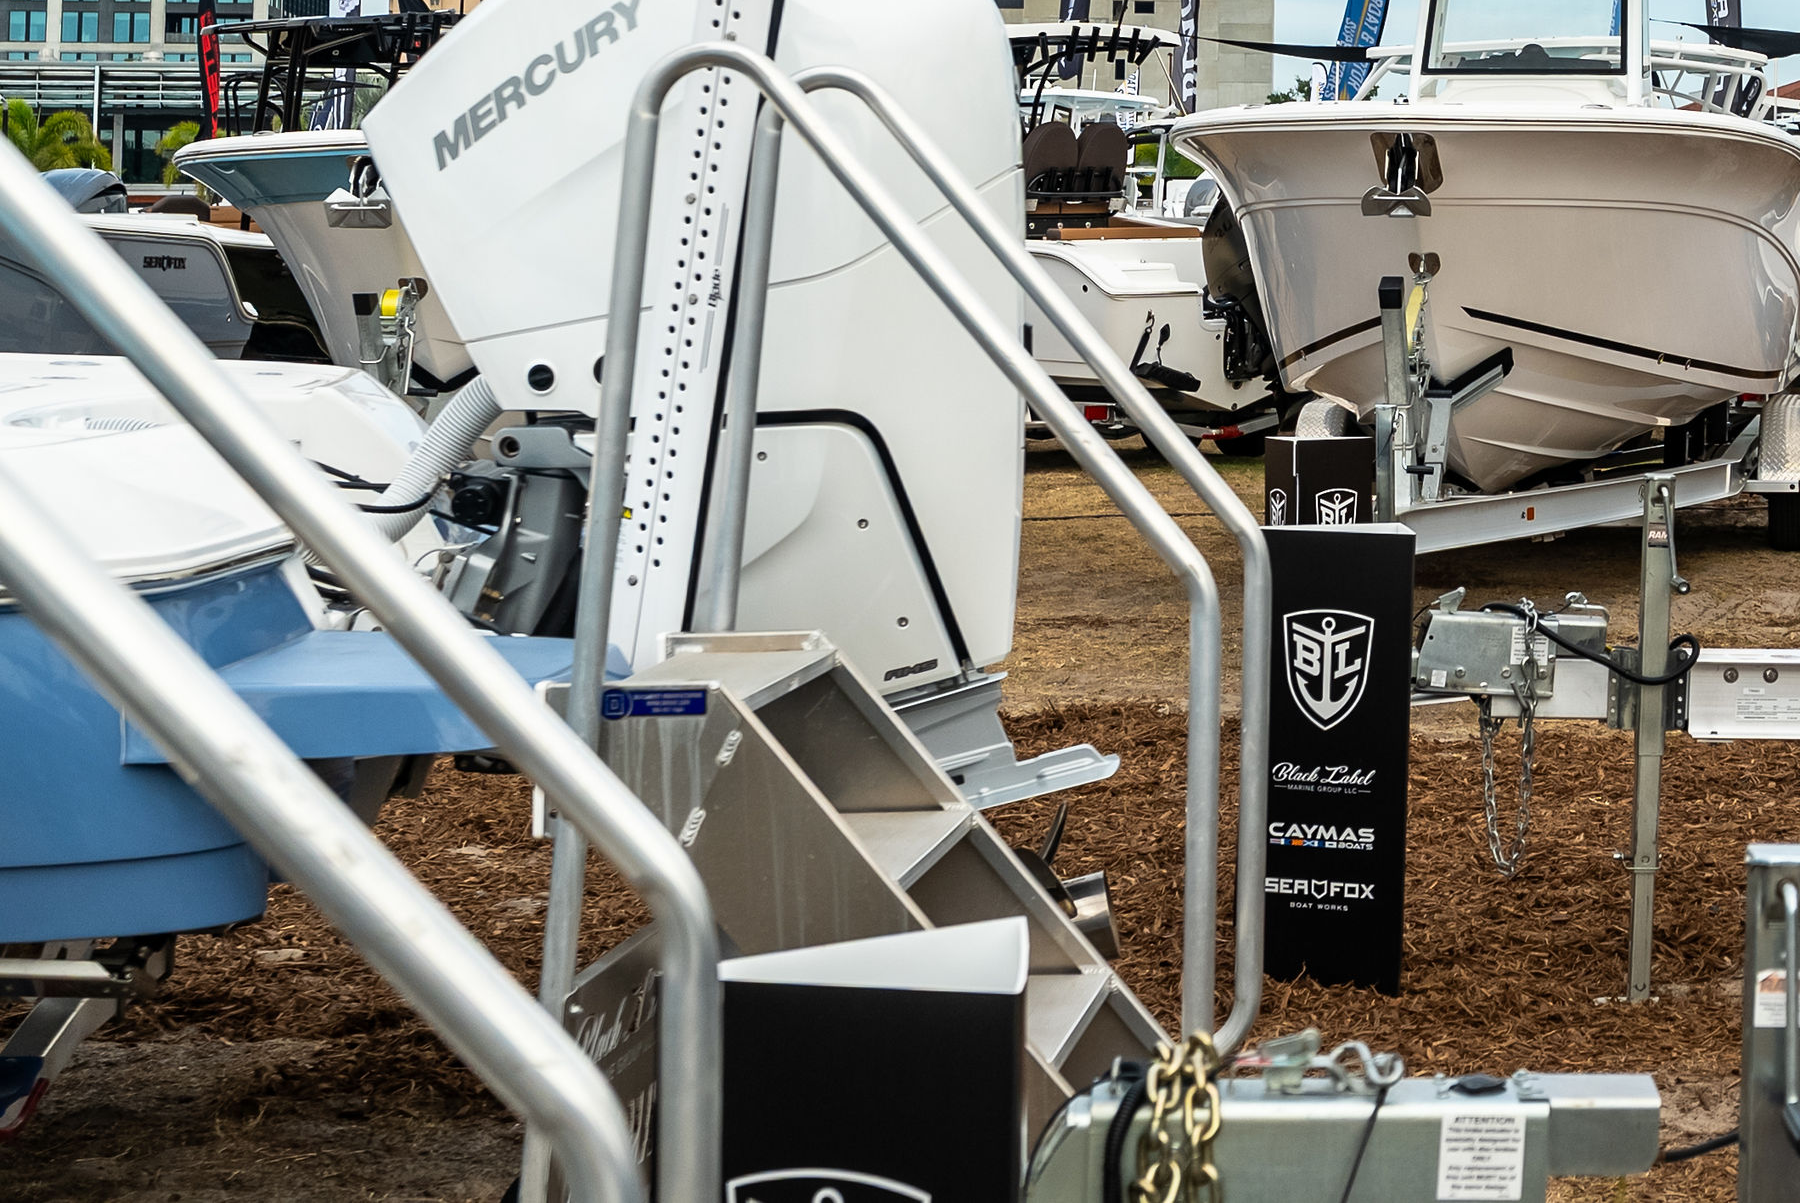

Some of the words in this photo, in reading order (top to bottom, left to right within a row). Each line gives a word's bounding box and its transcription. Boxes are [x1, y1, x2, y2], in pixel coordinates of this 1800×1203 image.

[1271, 761, 1321, 782] Black
[1320, 765, 1376, 786] Label
[1287, 783, 1315, 792] MARINE
[1316, 784, 1342, 793] GROUP
[1344, 786, 1358, 794] LLC
[1268, 821, 1375, 843] CAYMAS
[1337, 841, 1374, 851] BOATS
[1289, 901, 1313, 910] BOAT
[1317, 902, 1349, 912] WORKS
